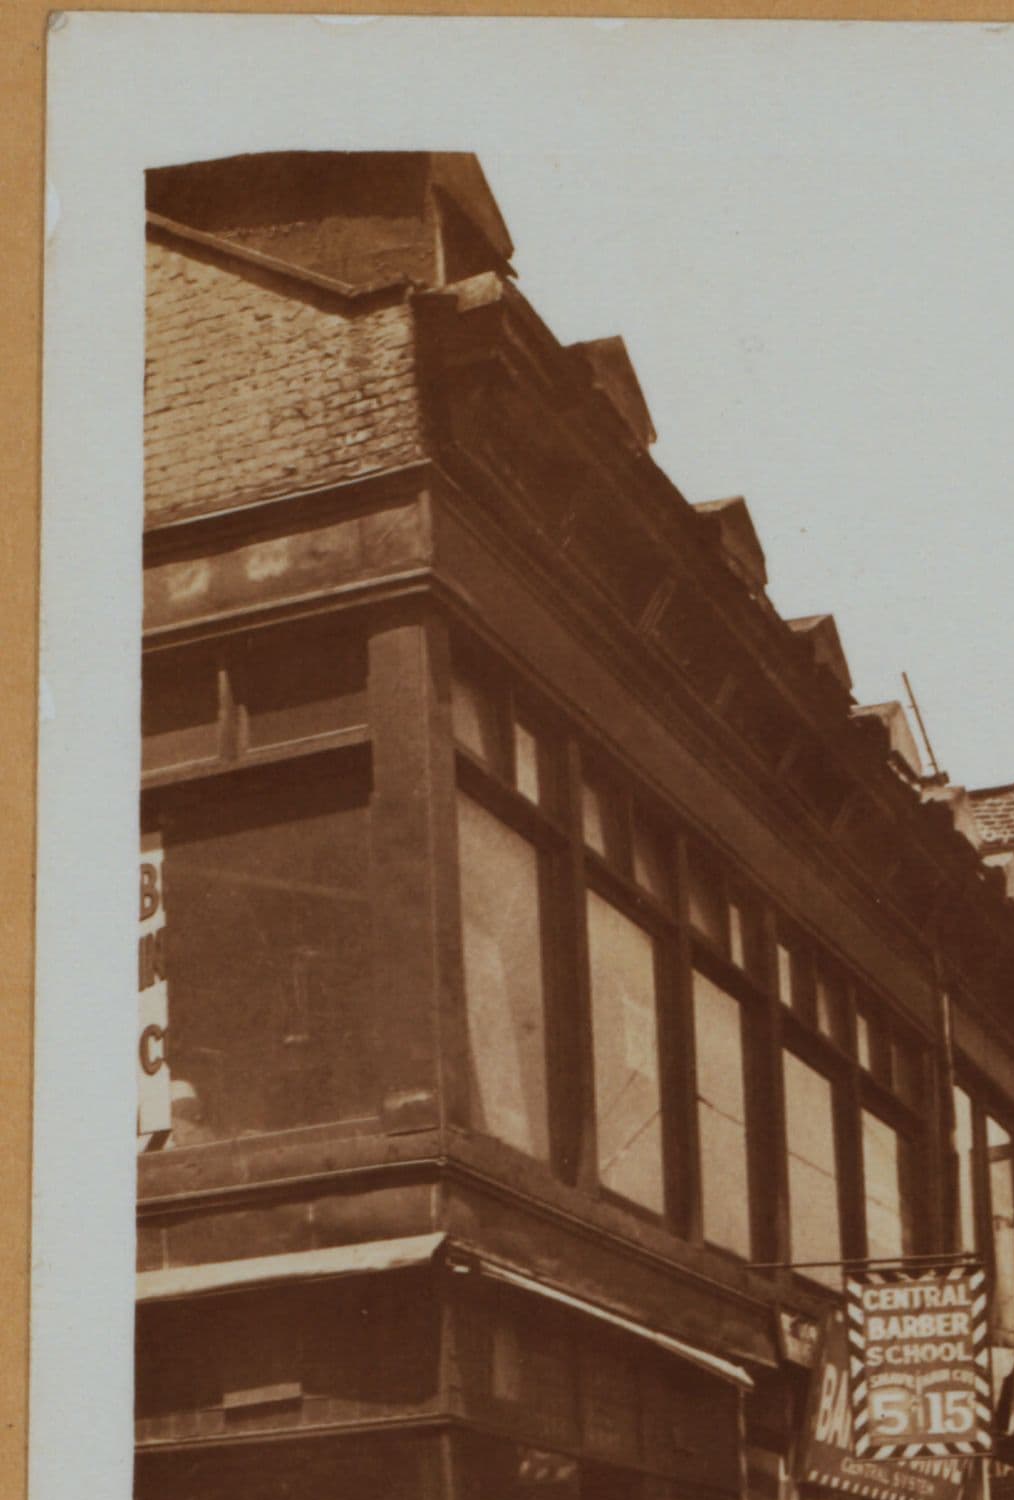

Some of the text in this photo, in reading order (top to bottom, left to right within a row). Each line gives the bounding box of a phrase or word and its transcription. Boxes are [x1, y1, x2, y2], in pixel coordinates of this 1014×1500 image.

[862, 1284, 972, 1312] CENTRAL
[867, 1313, 970, 1342] BARBER
[865, 1342, 973, 1367] SCHOOL
